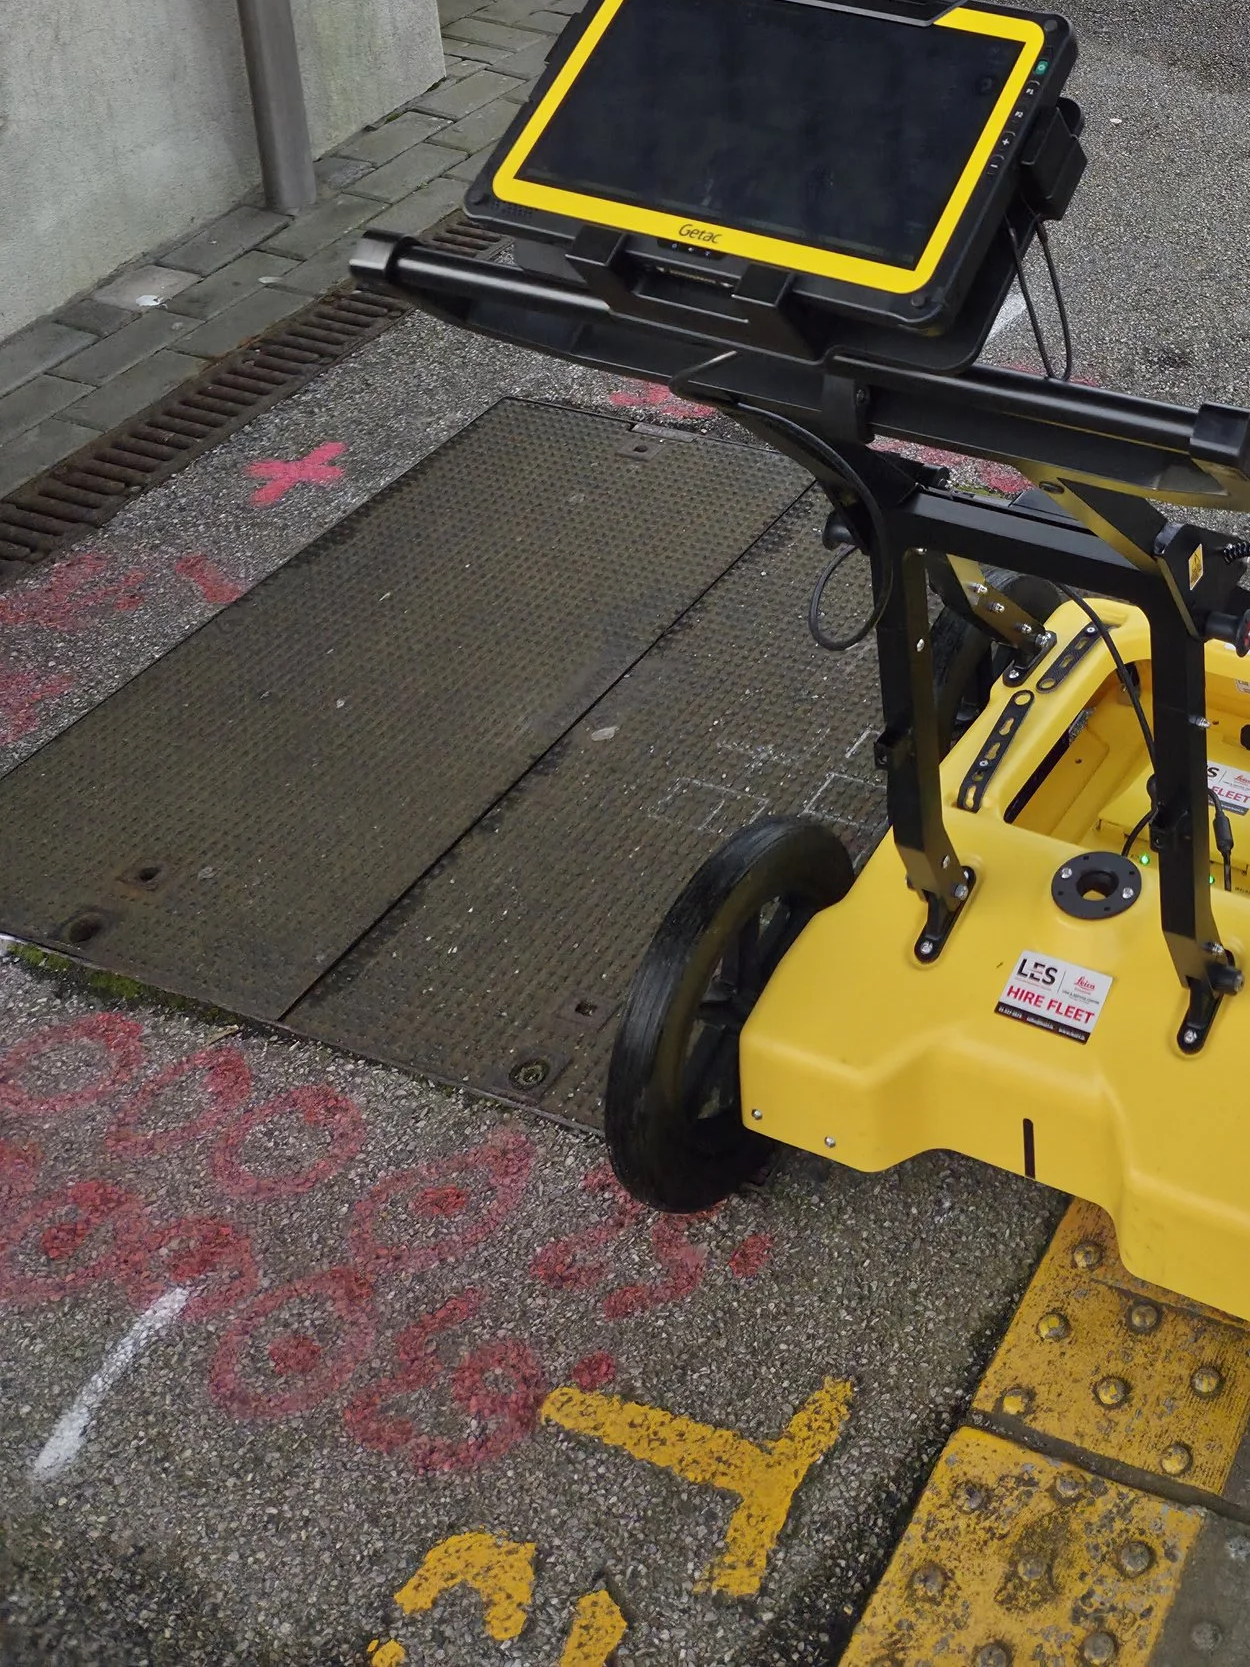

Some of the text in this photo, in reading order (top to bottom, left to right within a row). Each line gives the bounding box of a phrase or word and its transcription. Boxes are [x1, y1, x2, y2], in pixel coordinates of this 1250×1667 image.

[678, 223, 722, 244] Getac
[1016, 958, 1058, 986] LES
[1074, 975, 1096, 991] Leica
[1006, 985, 1045, 1008] HIRE
[1046, 998, 1095, 1024] FLEET
